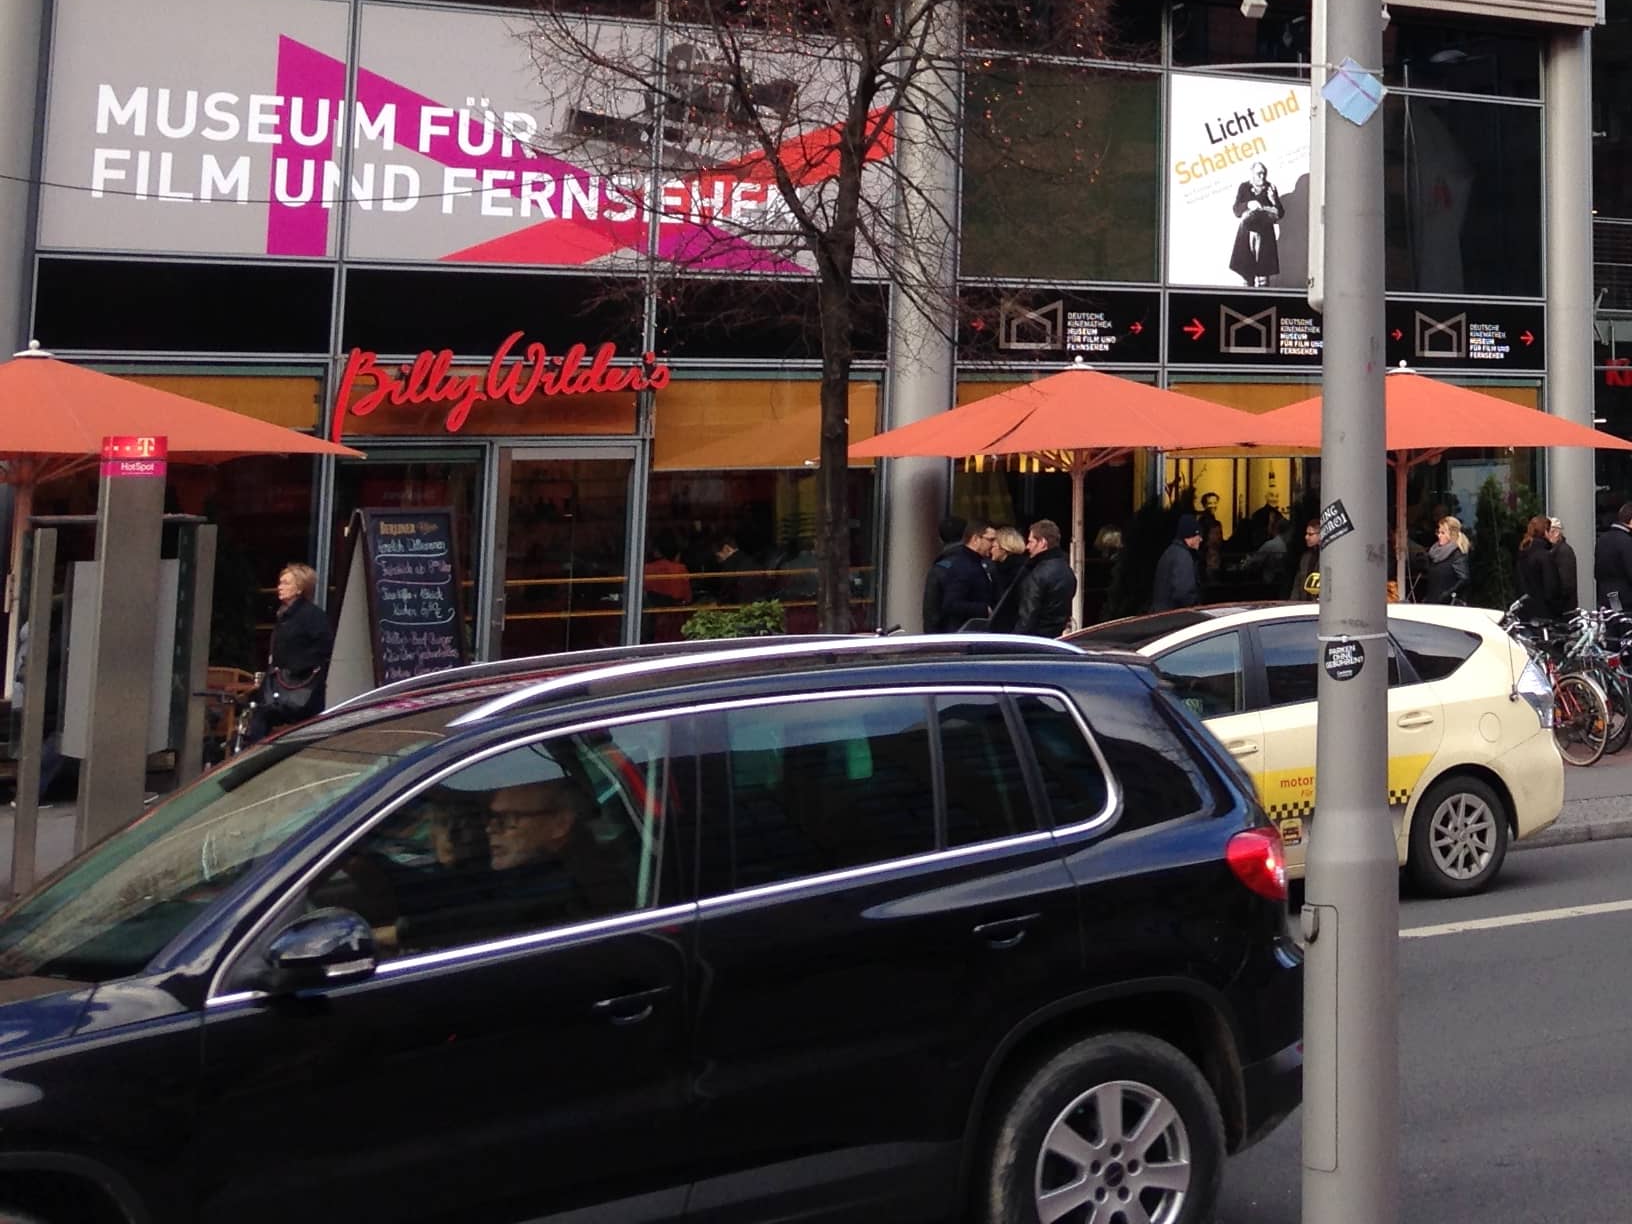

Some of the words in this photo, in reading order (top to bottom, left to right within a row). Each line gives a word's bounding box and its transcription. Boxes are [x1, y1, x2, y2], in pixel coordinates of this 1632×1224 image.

[96, 83, 397, 152] MUSEUM
[418, 96, 541, 159] FÜR
[1204, 107, 1260, 145] Licht
[1260, 89, 1301, 124] und
[91, 147, 252, 204] FILM
[273, 158, 422, 213] UND
[1174, 136, 1268, 185] Schatten
[331, 346, 485, 442] Billy
[120, 461, 155, 472] HotSpot
[1279, 776, 1314, 789] motor
